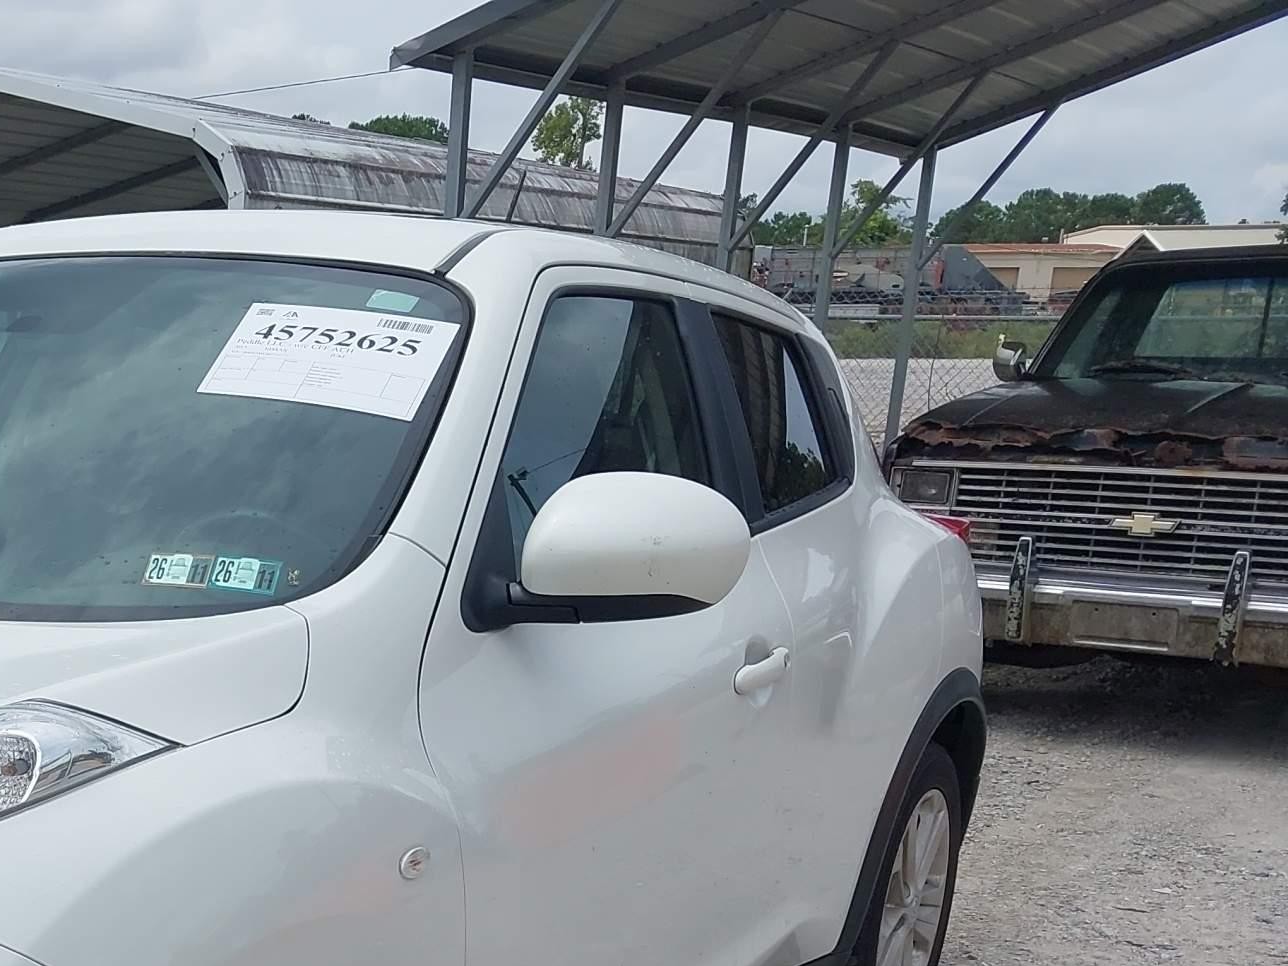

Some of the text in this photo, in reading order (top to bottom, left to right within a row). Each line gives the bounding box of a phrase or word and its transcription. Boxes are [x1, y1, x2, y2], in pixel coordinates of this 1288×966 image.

[254, 323, 422, 357] 45752625
[147, 557, 168, 580] 26
[213, 559, 276, 590] 26 11
